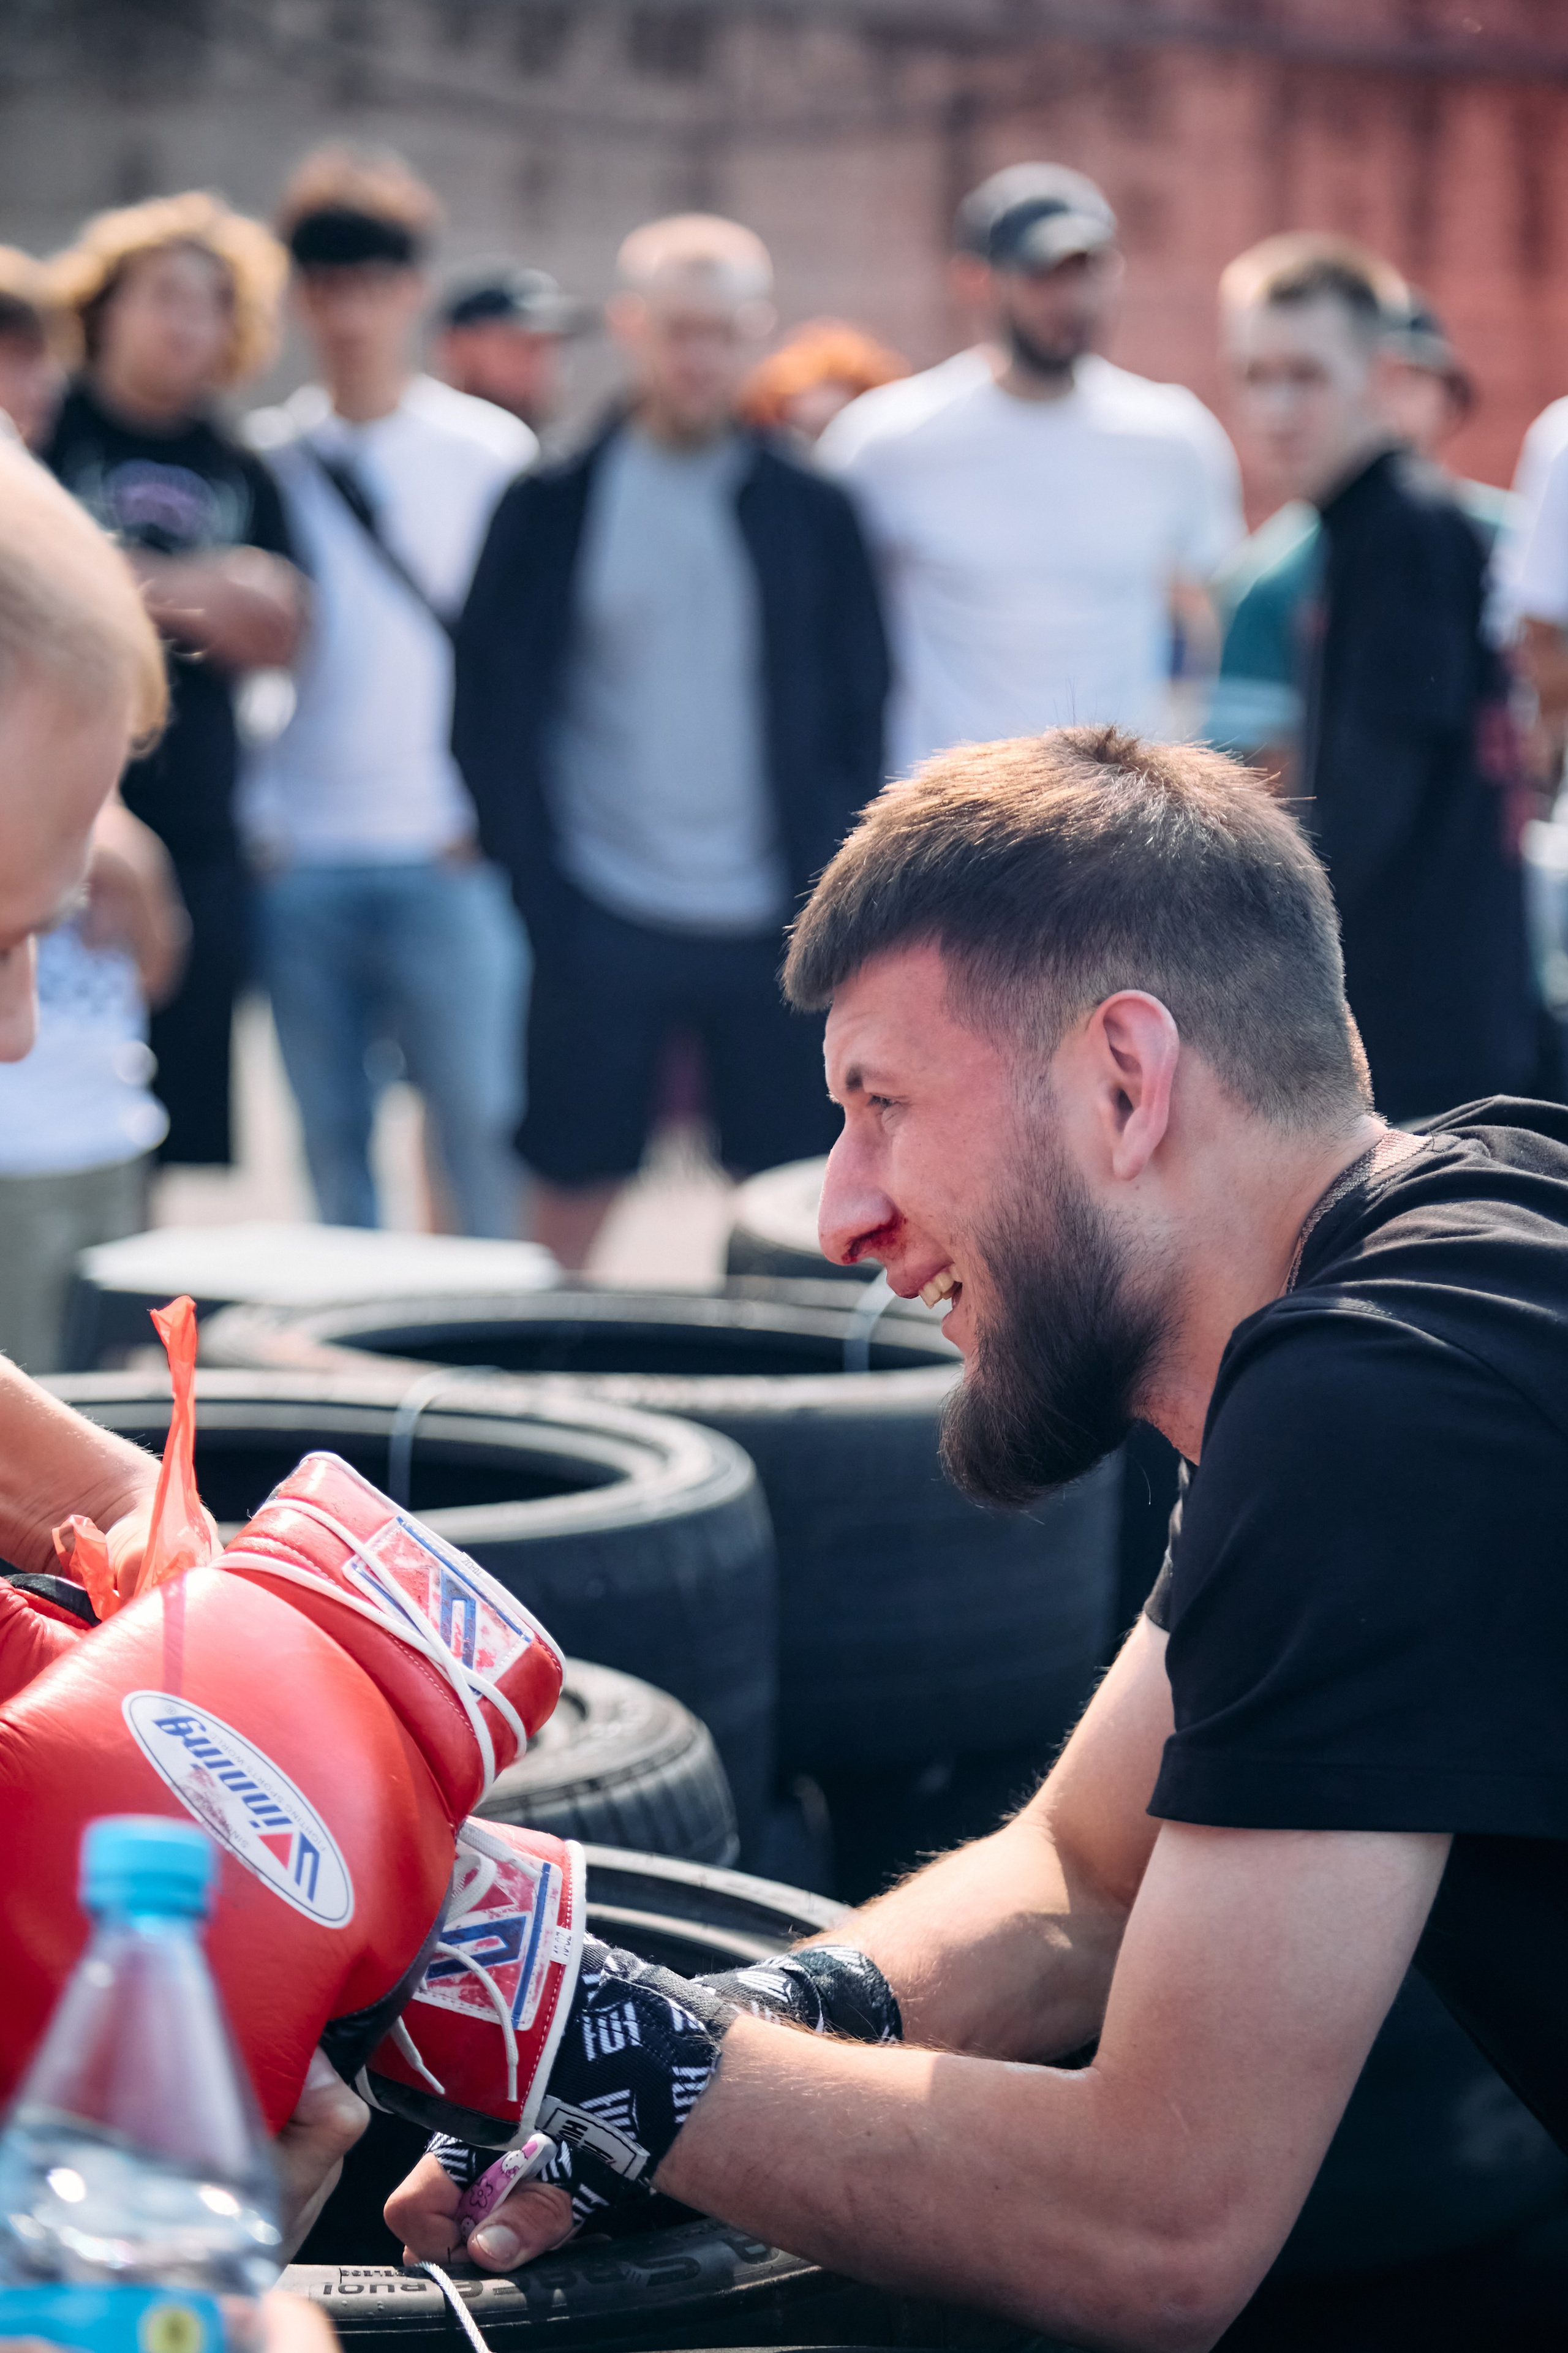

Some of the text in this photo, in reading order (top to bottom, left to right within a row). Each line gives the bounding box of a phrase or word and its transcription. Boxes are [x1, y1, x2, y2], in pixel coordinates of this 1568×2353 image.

[152, 1715, 320, 1903] Winning
[209, 1732, 326, 1851] FIGHTING SPORTS WORLD
